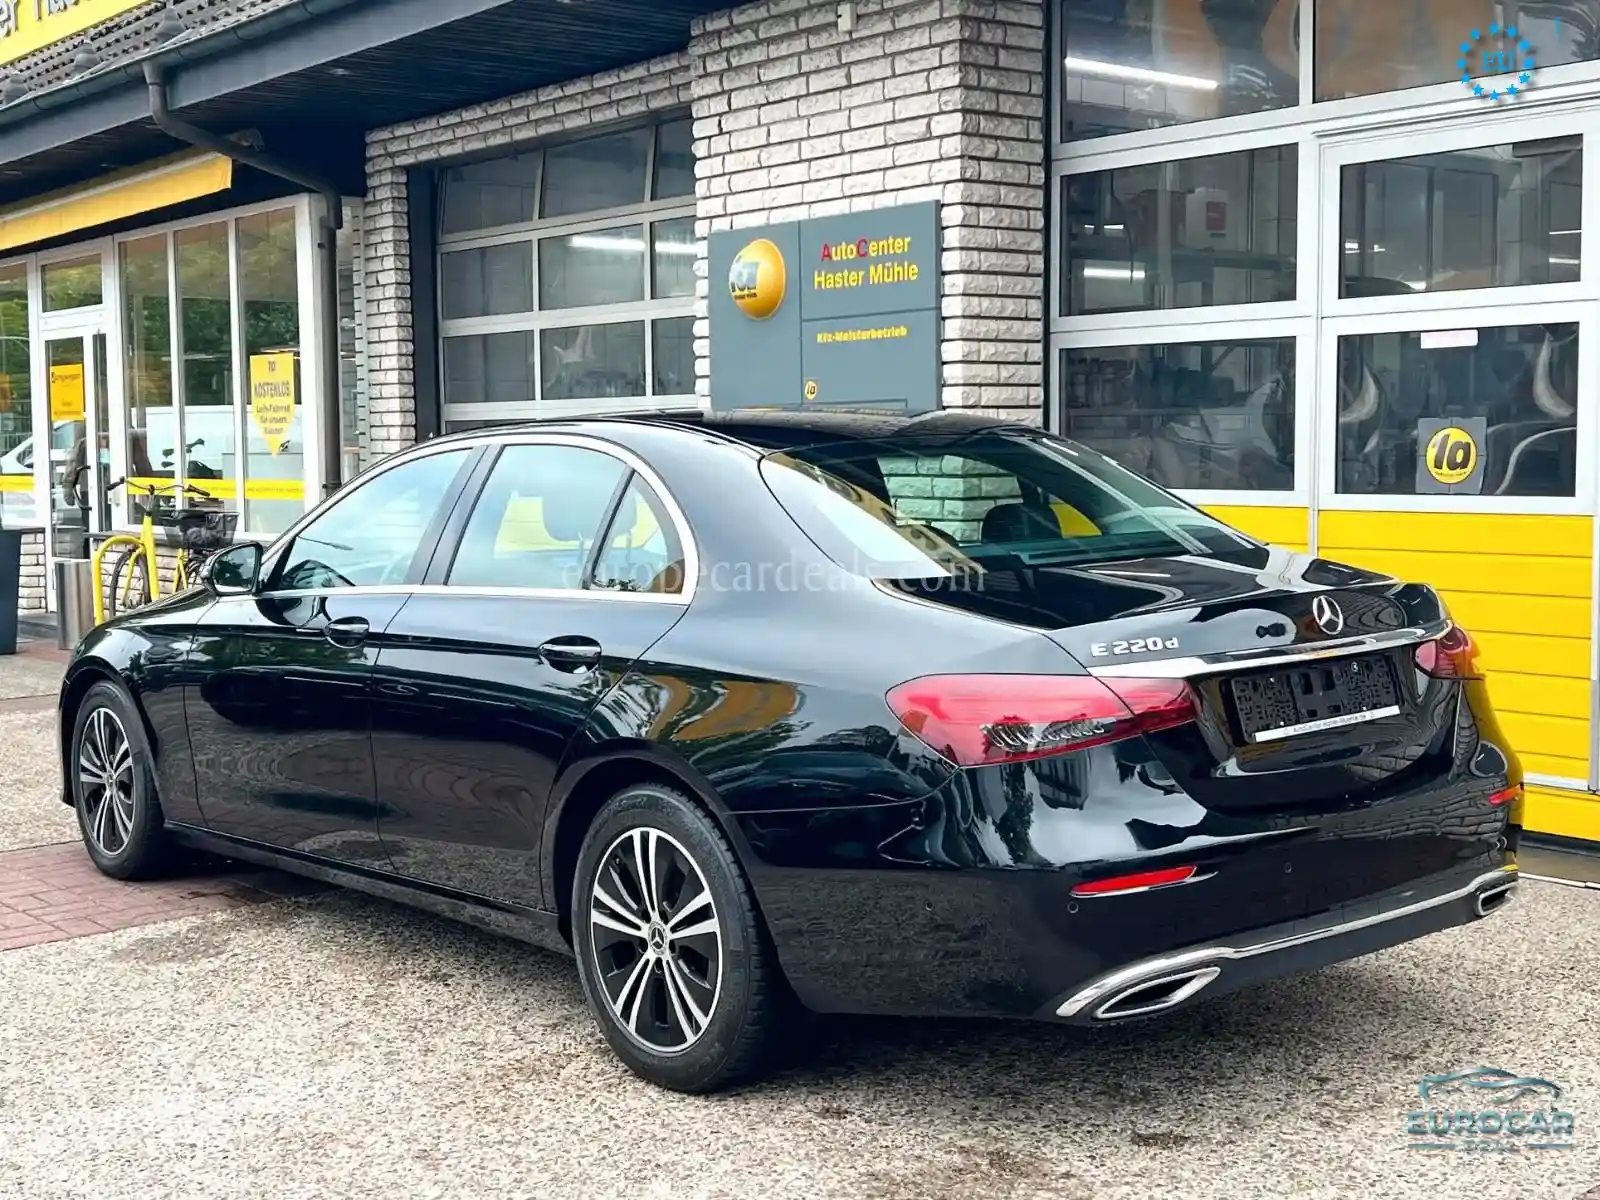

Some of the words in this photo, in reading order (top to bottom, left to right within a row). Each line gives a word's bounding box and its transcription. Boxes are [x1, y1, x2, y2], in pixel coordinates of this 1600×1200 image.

[820, 235, 911, 261] AutoCenter
[814, 266, 865, 290] Haster
[869, 260, 919, 285] Mühle
[816, 325, 908, 343] Kfz-Meisterbetrieb
[1431, 433, 1472, 470] 1a
[1091, 642, 1109, 657] E
[1111, 636, 1179, 655] 220d
